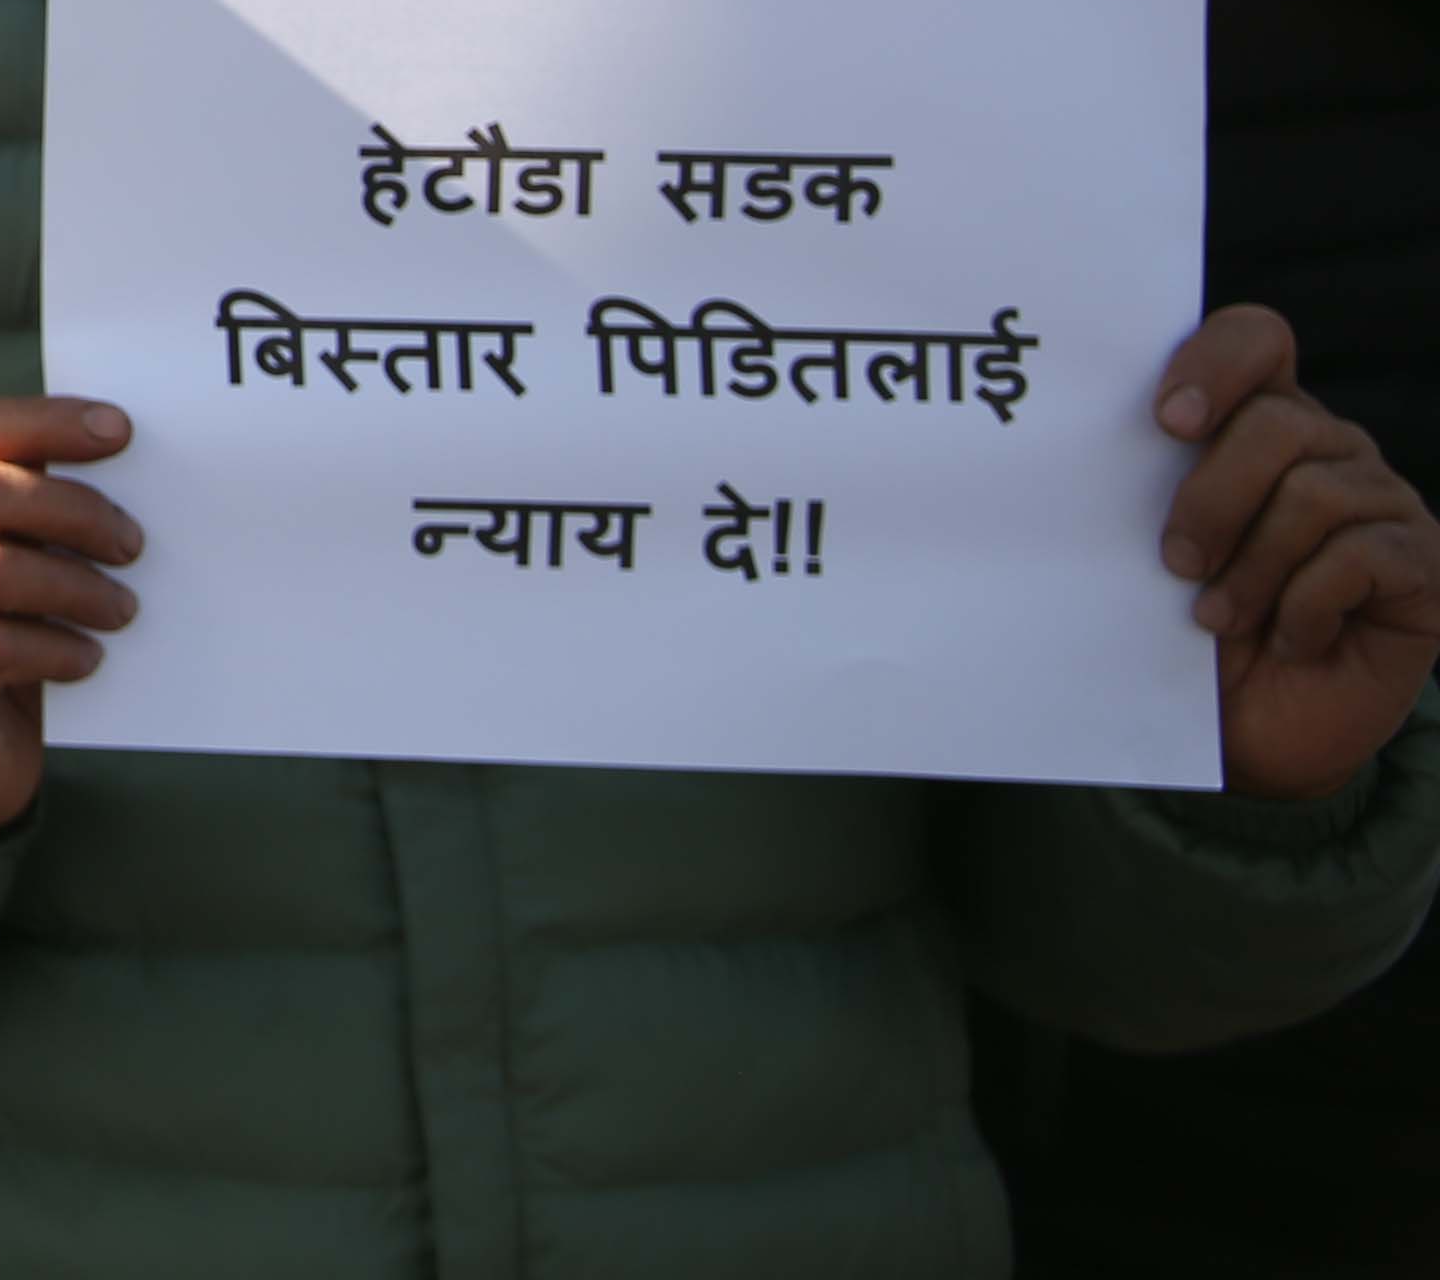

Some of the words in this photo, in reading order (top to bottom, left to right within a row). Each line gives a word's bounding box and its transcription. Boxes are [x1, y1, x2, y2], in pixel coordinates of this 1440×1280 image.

[356, 121, 606, 228] हेटौडा
[655, 149, 895, 225] सडक
[213, 287, 535, 398] बिस्तार
[583, 294, 1041, 425] पिडितलाई
[410, 496, 653, 571] न्याय
[700, 480, 827, 583] दे!!
